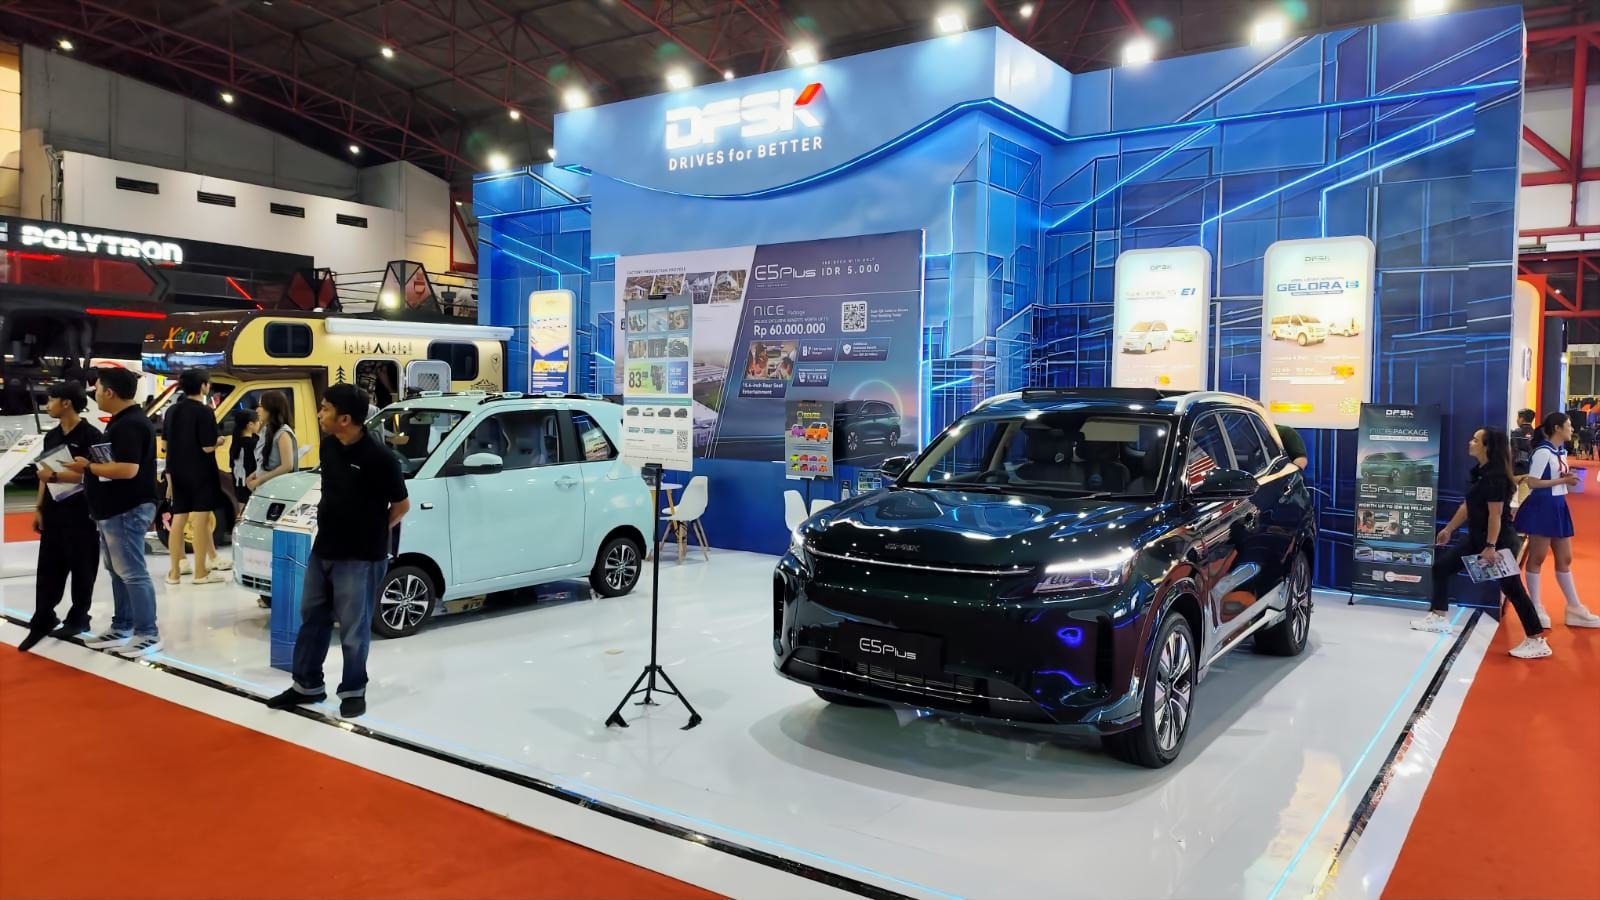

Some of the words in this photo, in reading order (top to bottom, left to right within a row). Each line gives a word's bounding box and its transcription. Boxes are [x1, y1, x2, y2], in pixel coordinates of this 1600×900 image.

[665, 83, 824, 150] DFSK
[668, 150, 725, 171] DRIVES
[728, 148, 752, 161] for
[757, 136, 823, 158] BETTER
[21, 225, 183, 265] POLYTRON
[821, 266, 841, 277] IDR
[847, 263, 880, 275] 5.000
[1276, 281, 1342, 292] GELORA
[753, 325, 767, 338] Rp
[769, 323, 826, 336] 60.000.000
[628, 371, 642, 388] 83
